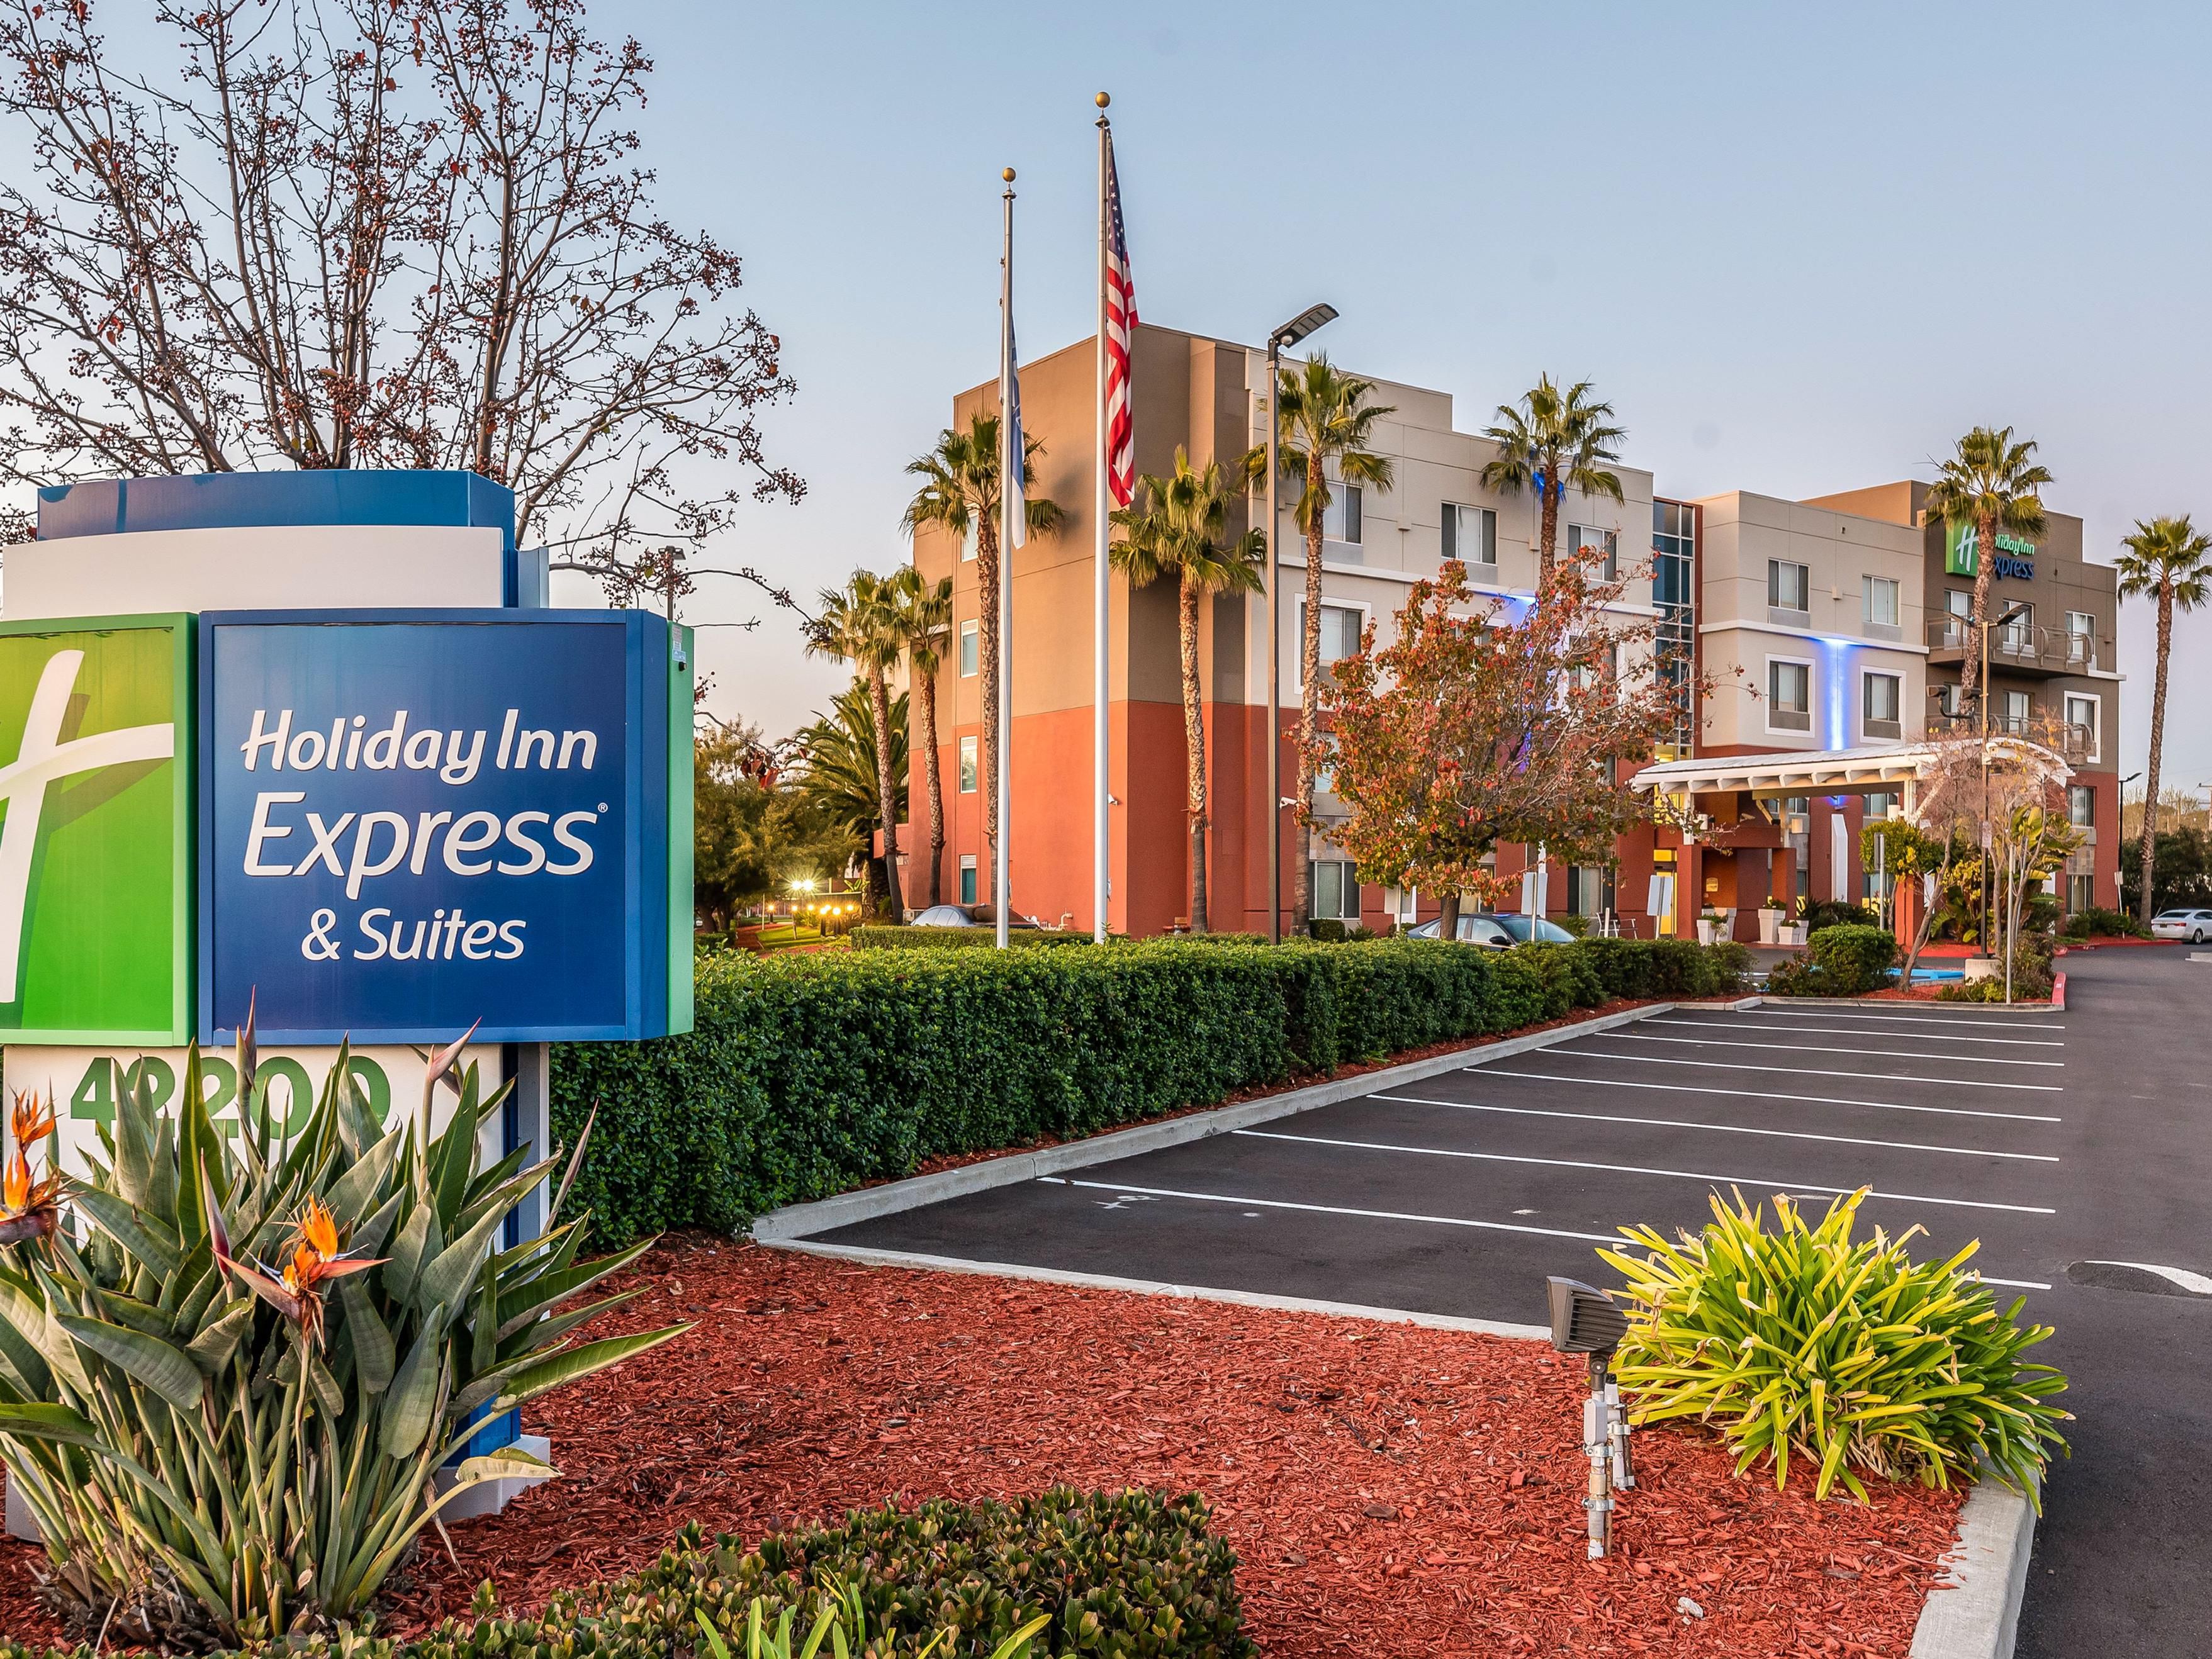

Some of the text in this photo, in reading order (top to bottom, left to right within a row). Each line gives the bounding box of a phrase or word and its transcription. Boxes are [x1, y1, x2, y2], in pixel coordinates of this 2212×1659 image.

[1995, 533, 2035, 556] liday Inn
[1994, 557, 2035, 579] xpress
[240, 709, 597, 785] Holiday Inn
[301, 908, 526, 961] & Suites
